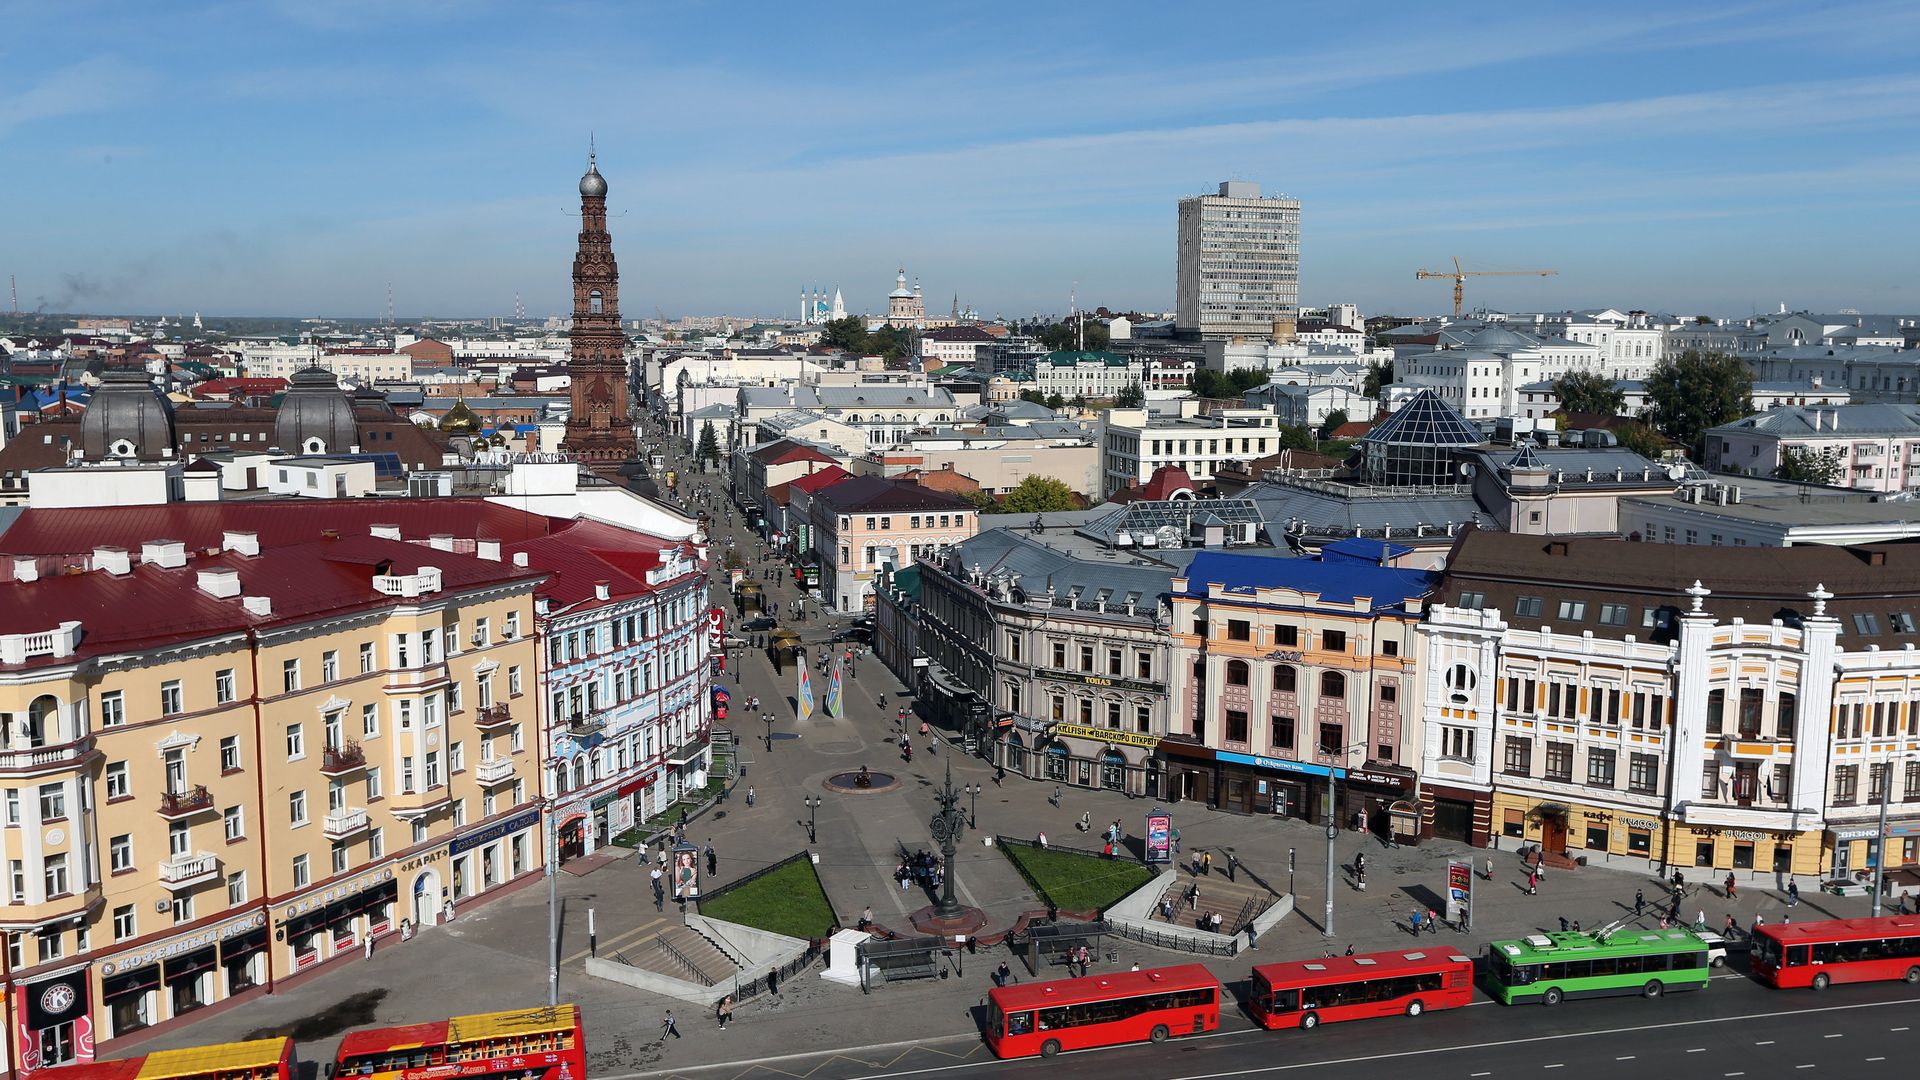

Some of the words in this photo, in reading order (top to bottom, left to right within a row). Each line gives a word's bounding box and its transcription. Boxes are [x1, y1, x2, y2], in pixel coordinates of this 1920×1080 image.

[709, 613, 721, 648] KFC
[1084, 676, 1112, 686] ТОПАЗ
[1057, 725, 1087, 736] KILLFISH
[509, 814, 535, 830] САЛОН
[1583, 810, 1613, 822] кафе
[1690, 827, 1721, 838] кафе
[407, 851, 442, 871] КАРАТ
[118, 929, 219, 971] КОФЕЙНЫЙ
[221, 917, 255, 940] ДОМ
